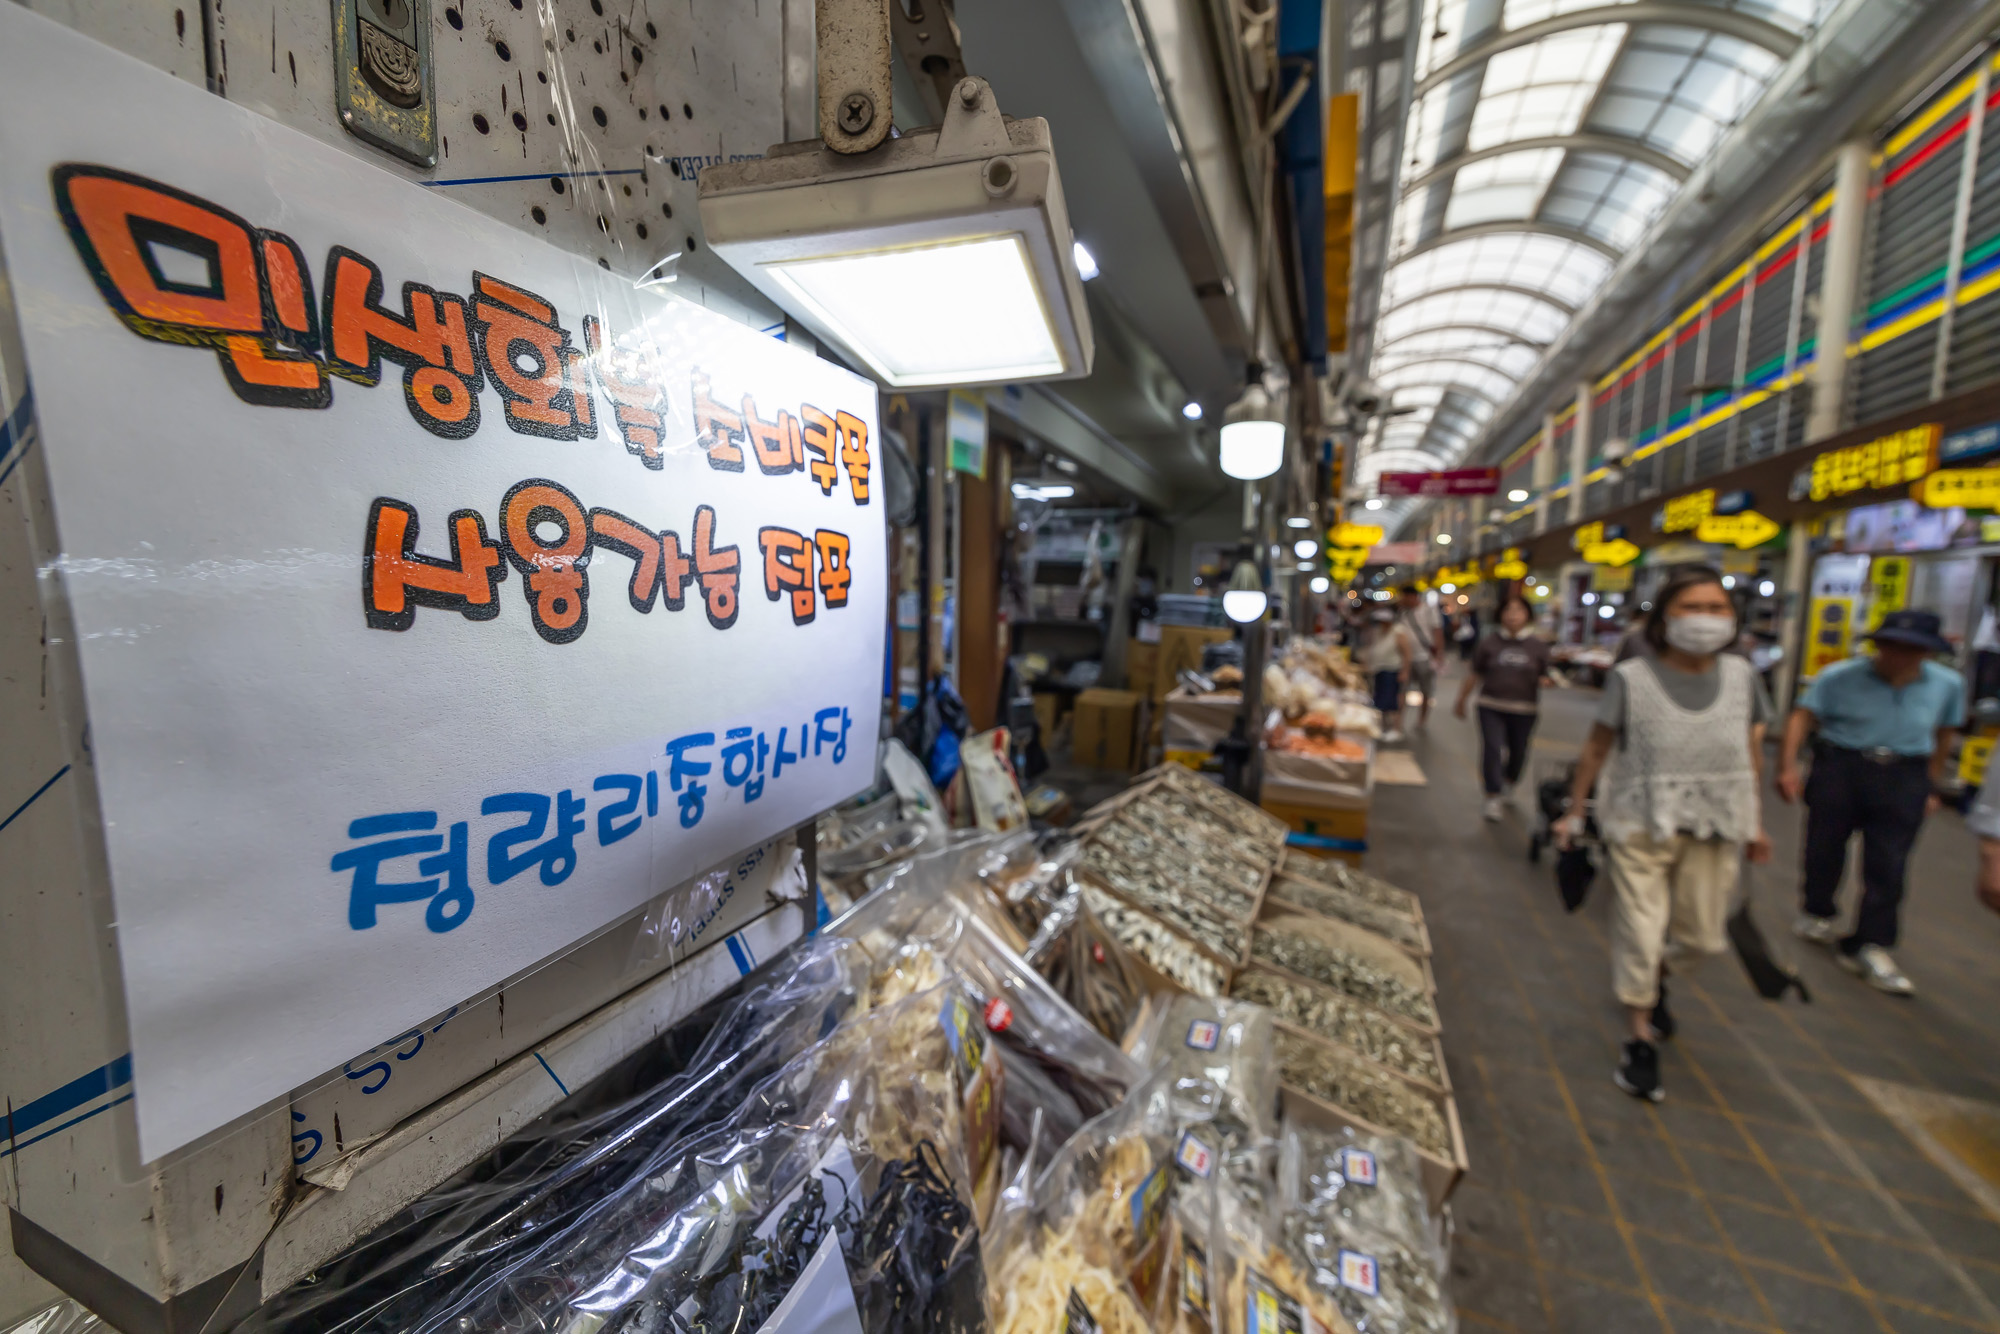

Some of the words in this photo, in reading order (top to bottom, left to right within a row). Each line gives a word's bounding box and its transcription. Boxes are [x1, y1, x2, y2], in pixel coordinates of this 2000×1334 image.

[53, 162, 668, 471] 민생회복
[690, 364, 871, 506] 소비쿠폰
[363, 478, 740, 645] 사용가능
[758, 524, 851, 626] 점포
[331, 706, 852, 933] 청량리종합시장
